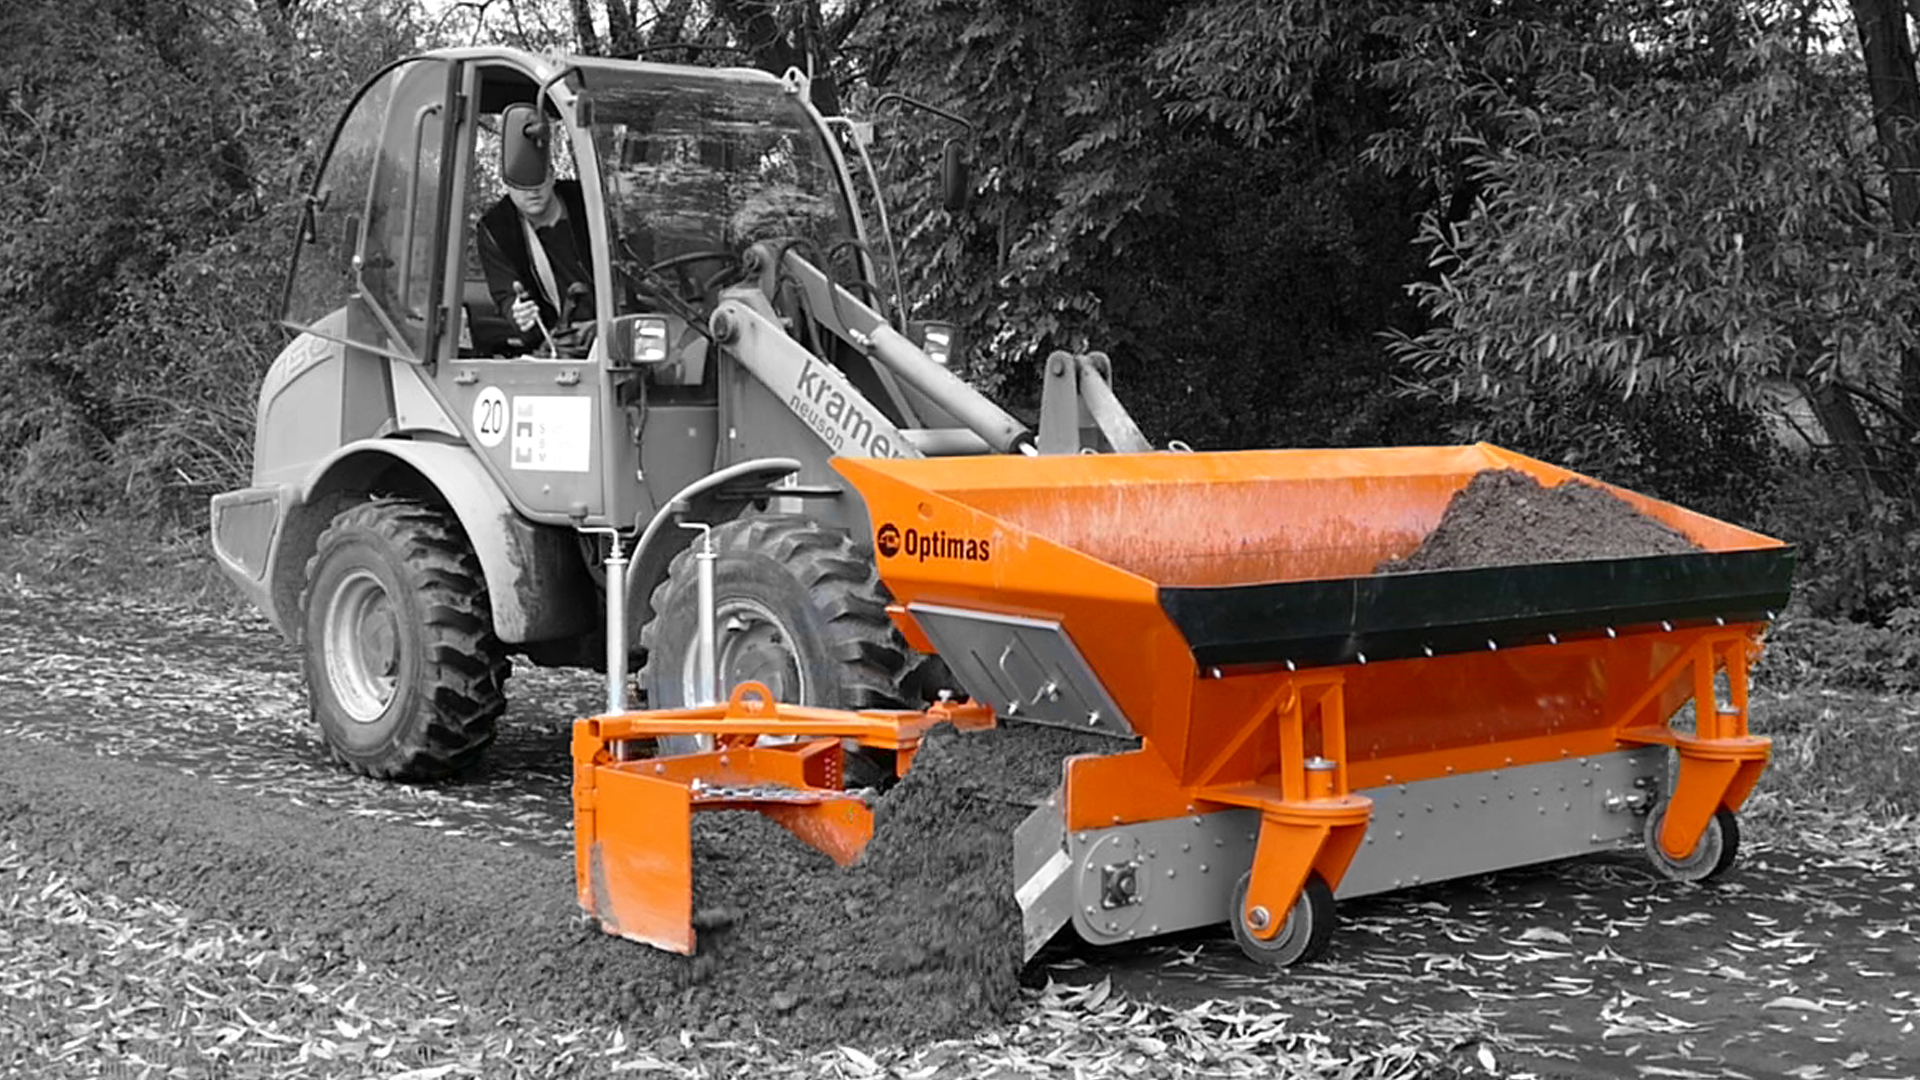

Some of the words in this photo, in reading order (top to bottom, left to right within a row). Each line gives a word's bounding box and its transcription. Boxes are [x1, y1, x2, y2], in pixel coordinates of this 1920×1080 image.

[481, 398, 502, 434] 20
[790, 395, 844, 449] neuson
[904, 528, 990, 563] Optimas
